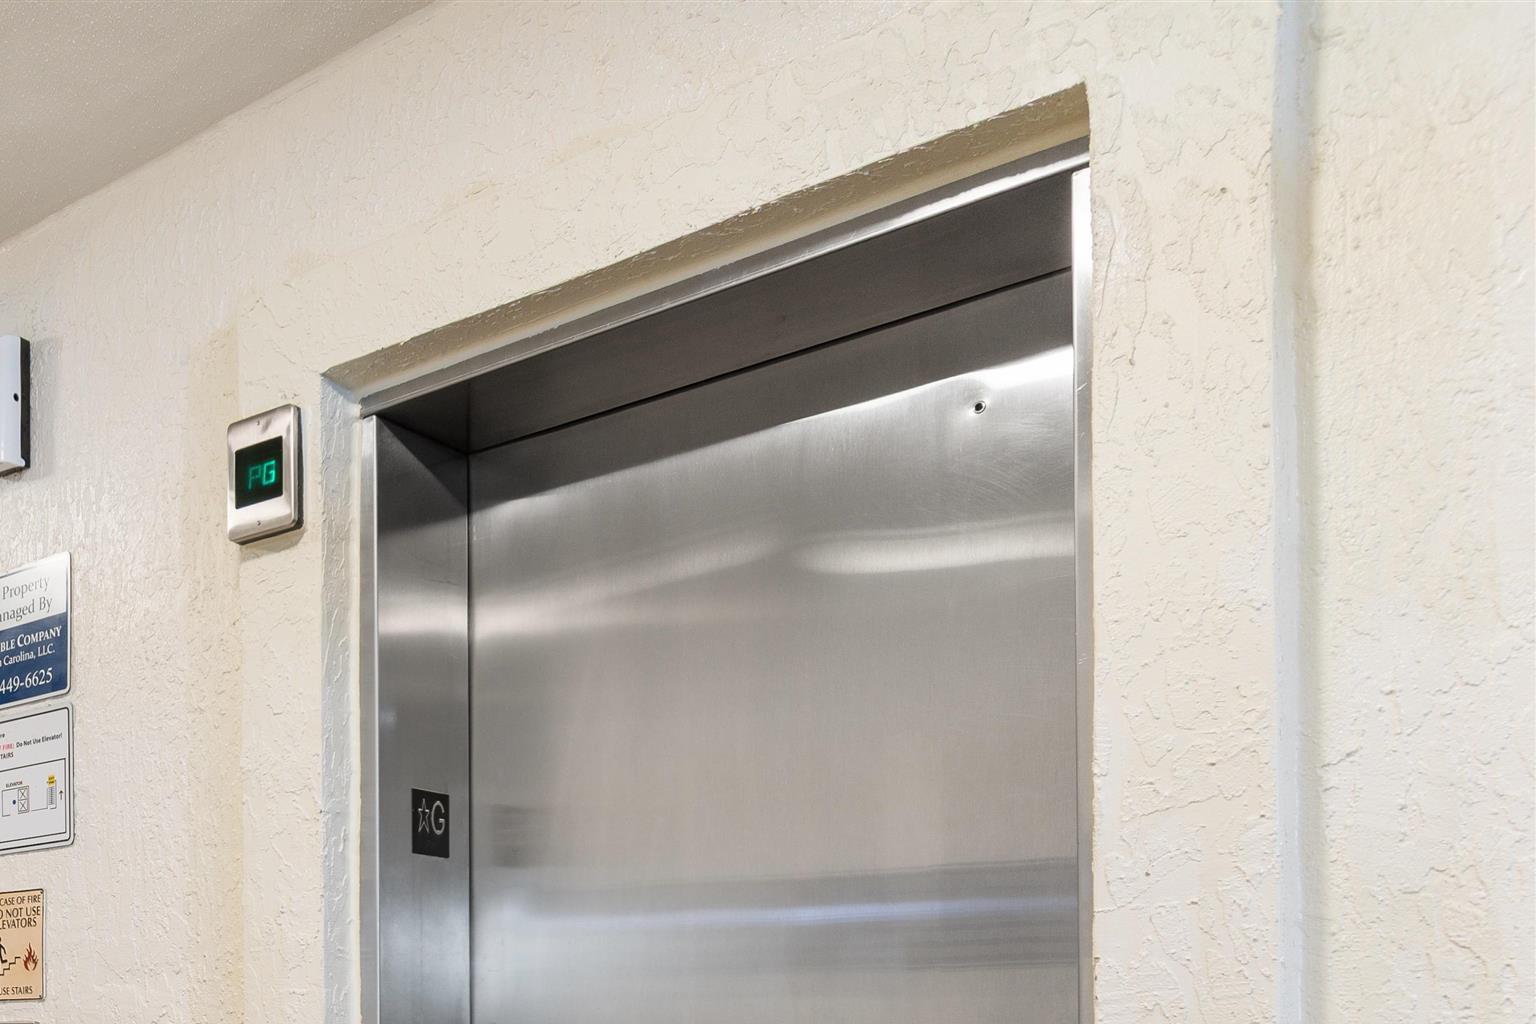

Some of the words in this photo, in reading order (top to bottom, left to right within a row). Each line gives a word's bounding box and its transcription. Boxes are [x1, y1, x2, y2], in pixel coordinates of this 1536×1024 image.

[248, 460, 276, 490] PG
[2, 577, 50, 600] Property
[39, 596, 52, 612] By
[17, 626, 62, 647] COMPANY
[3, 650, 36, 666] Carolina,
[38, 643, 56, 656] LLC.
[16, 740, 23, 748] Do
[33, 737, 41, 745] Use
[431, 800, 445, 835] G
[0, 897, 15, 906] CASE
[16, 896, 25, 905] OF
[28, 894, 41, 904] FIRE
[6, 908, 23, 918] NOT
[26, 906, 40, 916] USE
[11, 986, 33, 995] STAIRS
